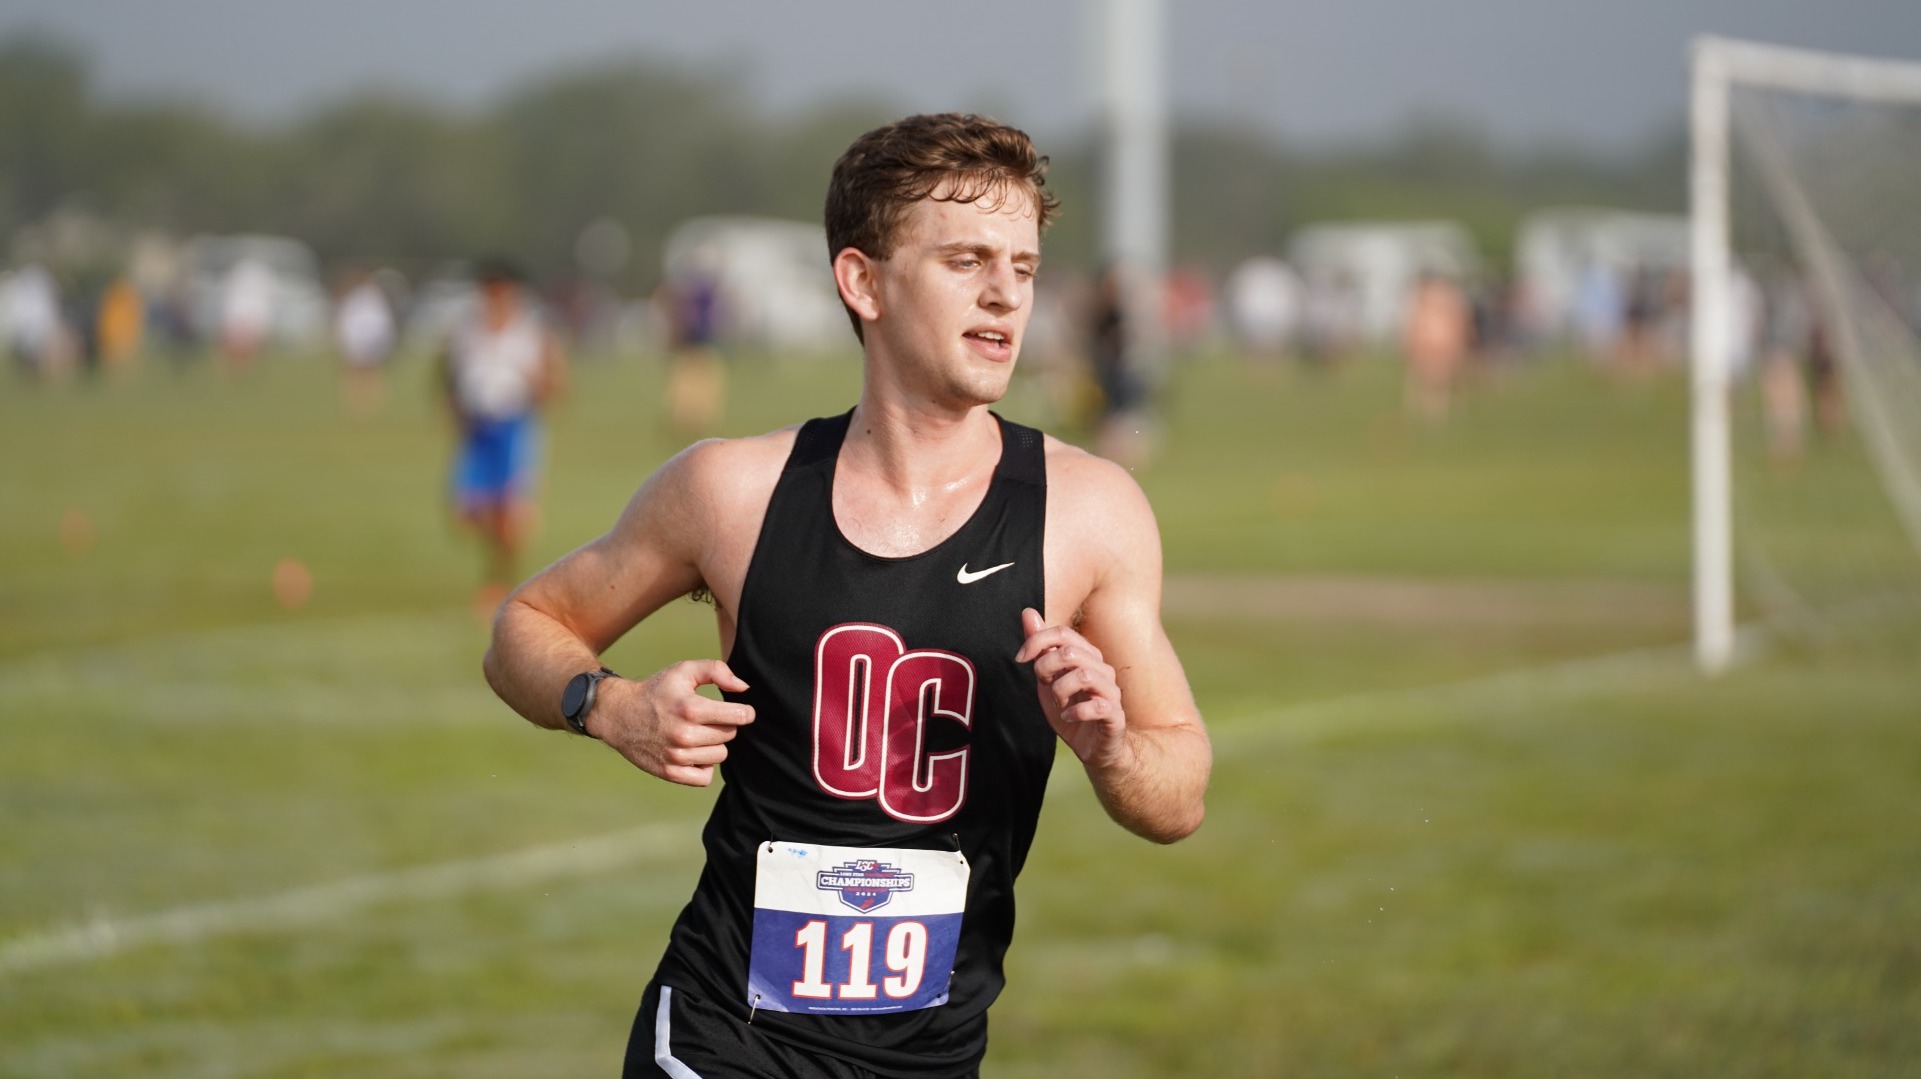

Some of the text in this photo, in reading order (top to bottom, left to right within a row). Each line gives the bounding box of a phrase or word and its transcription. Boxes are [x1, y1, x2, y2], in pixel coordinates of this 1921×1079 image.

[811, 621, 977, 824] OC
[821, 877, 910, 887] CHAMPIONSHIPS
[791, 919, 929, 1000] 119
